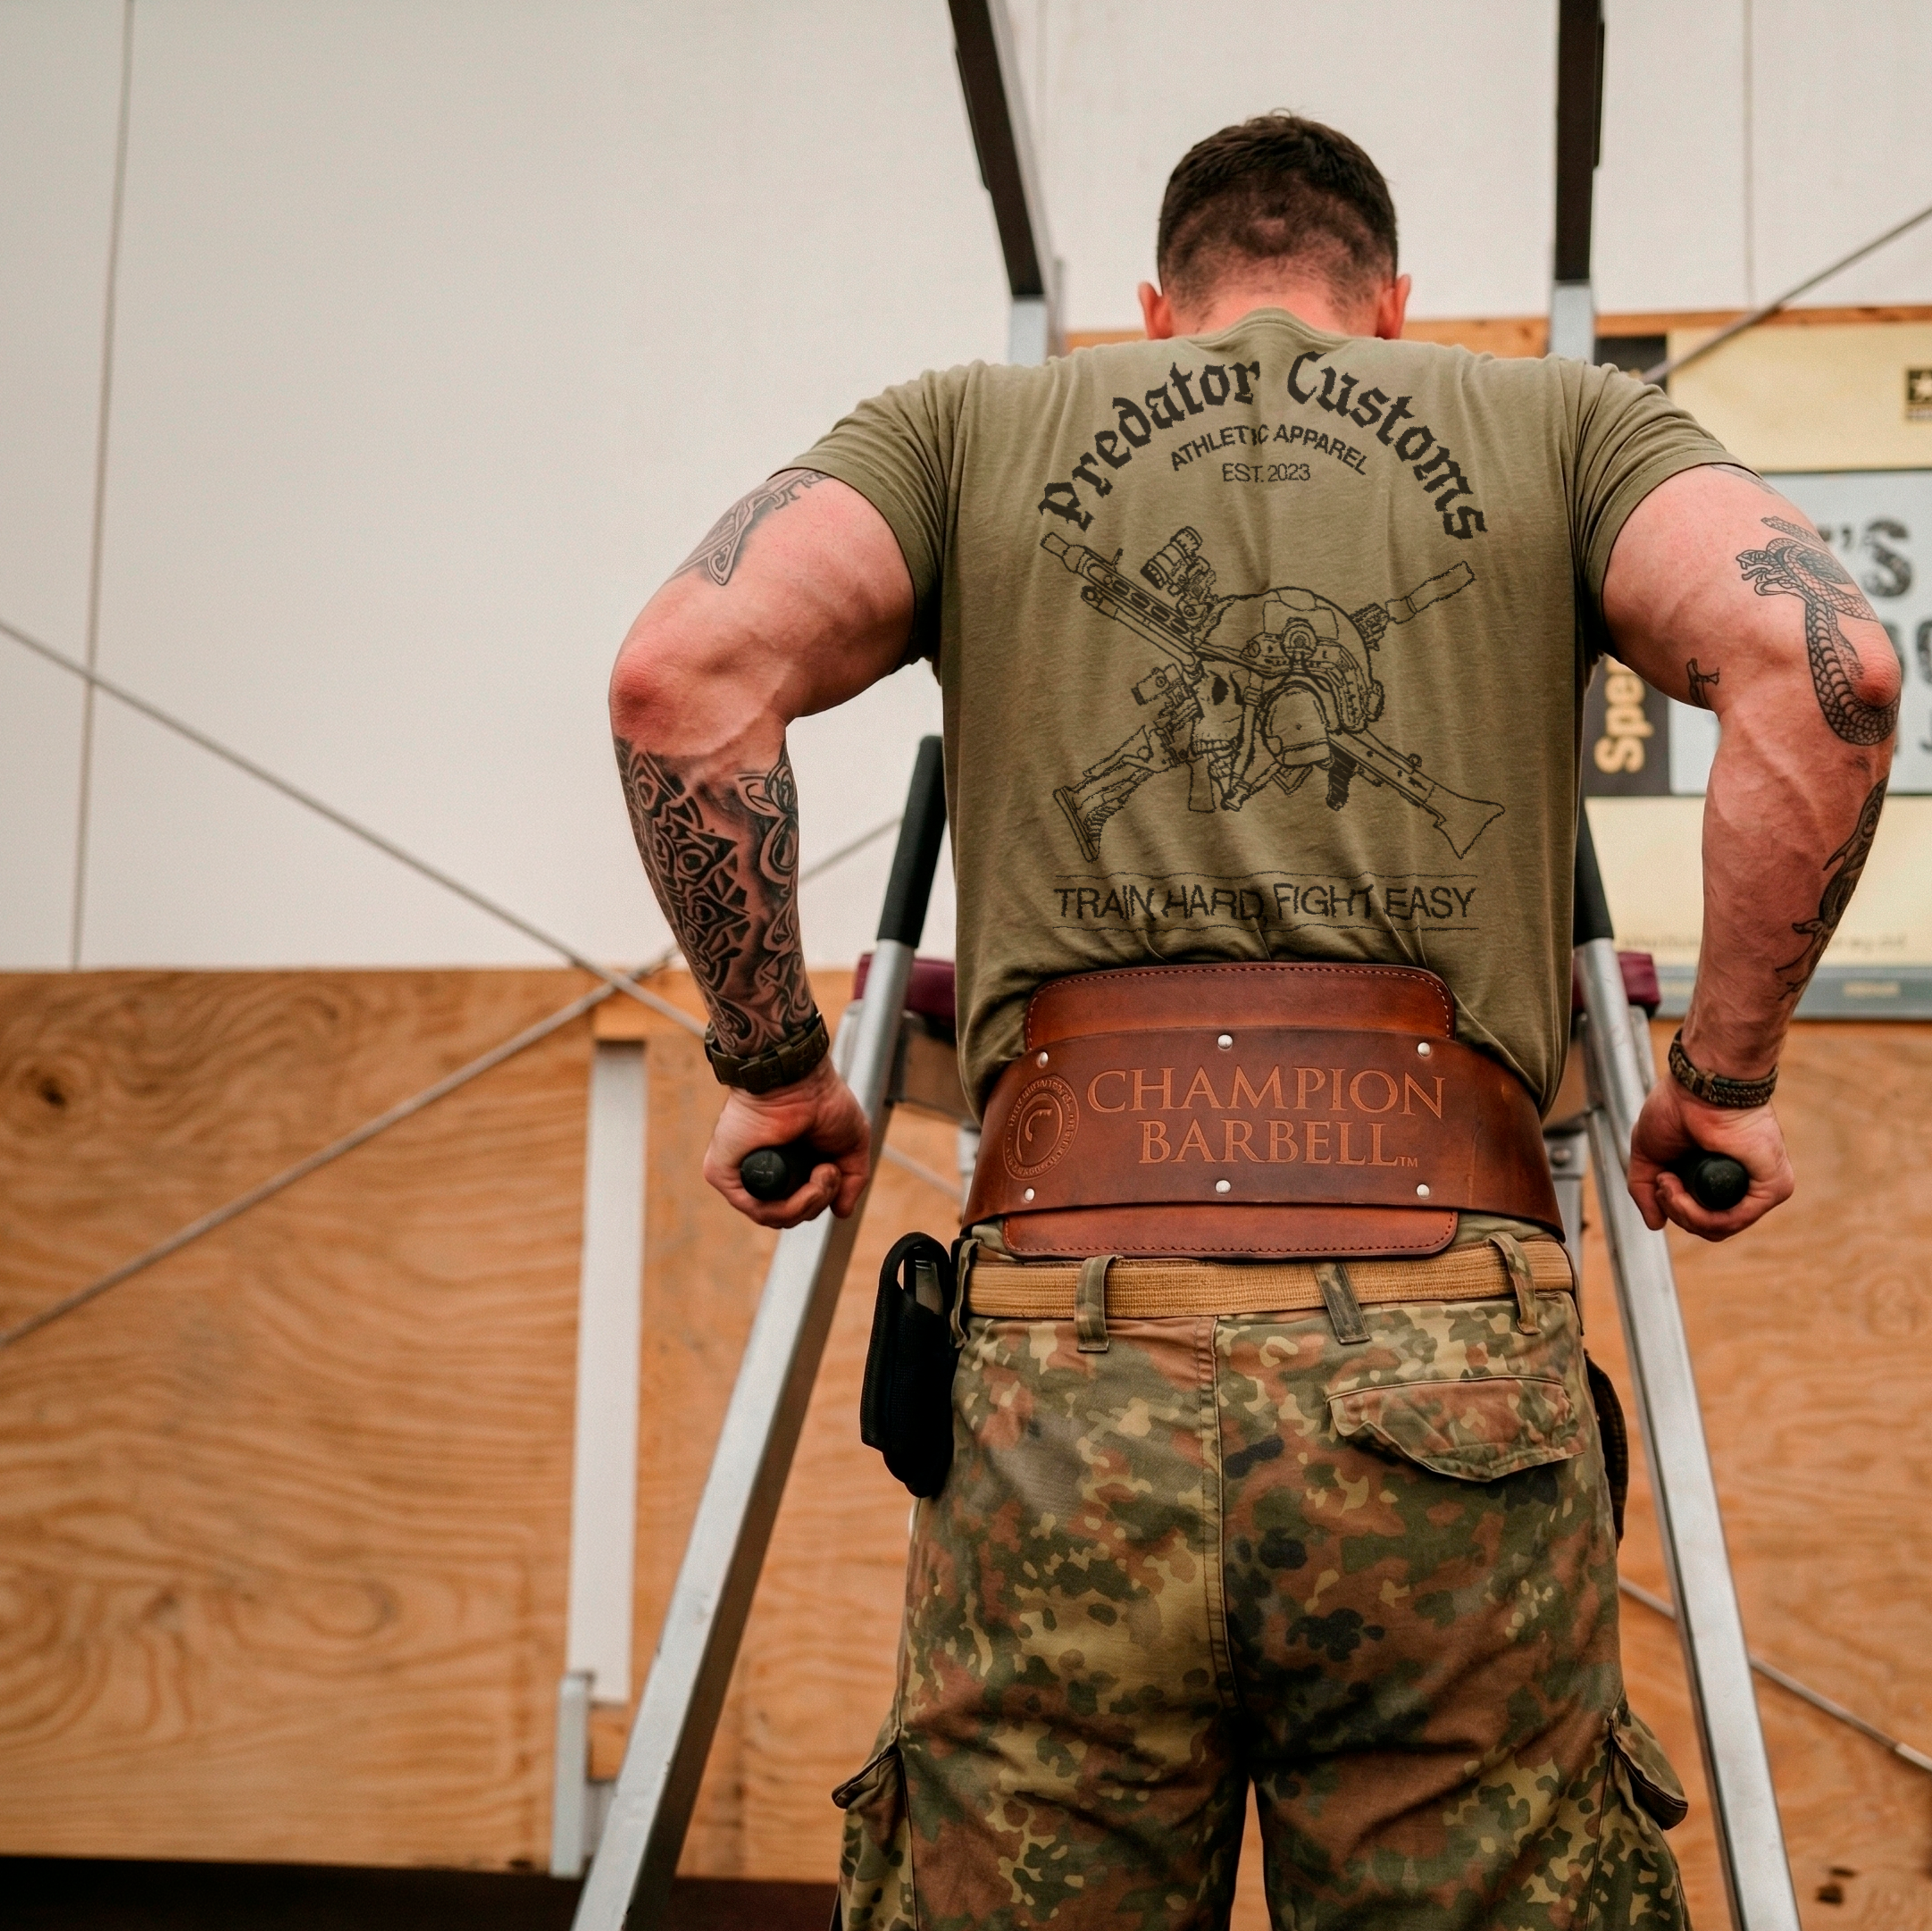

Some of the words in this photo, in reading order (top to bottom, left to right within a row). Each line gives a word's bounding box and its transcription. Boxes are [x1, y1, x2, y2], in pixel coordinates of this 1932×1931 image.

[1038, 361, 1259, 531] Predator
[1286, 350, 1488, 540] Customs
[1171, 423, 1269, 472] ATHLETIC
[1273, 423, 1367, 476] APPAREL
[1221, 463, 1264, 483] EST.
[1267, 463, 1311, 482] 2023
[1053, 884, 1157, 921] TRAIN
[1273, 882, 1375, 920] FIGHT
[1384, 885, 1476, 921] EASY
[1087, 1065, 1446, 1120] CHAMPION
[1137, 1118, 1398, 1167] BARBELL
